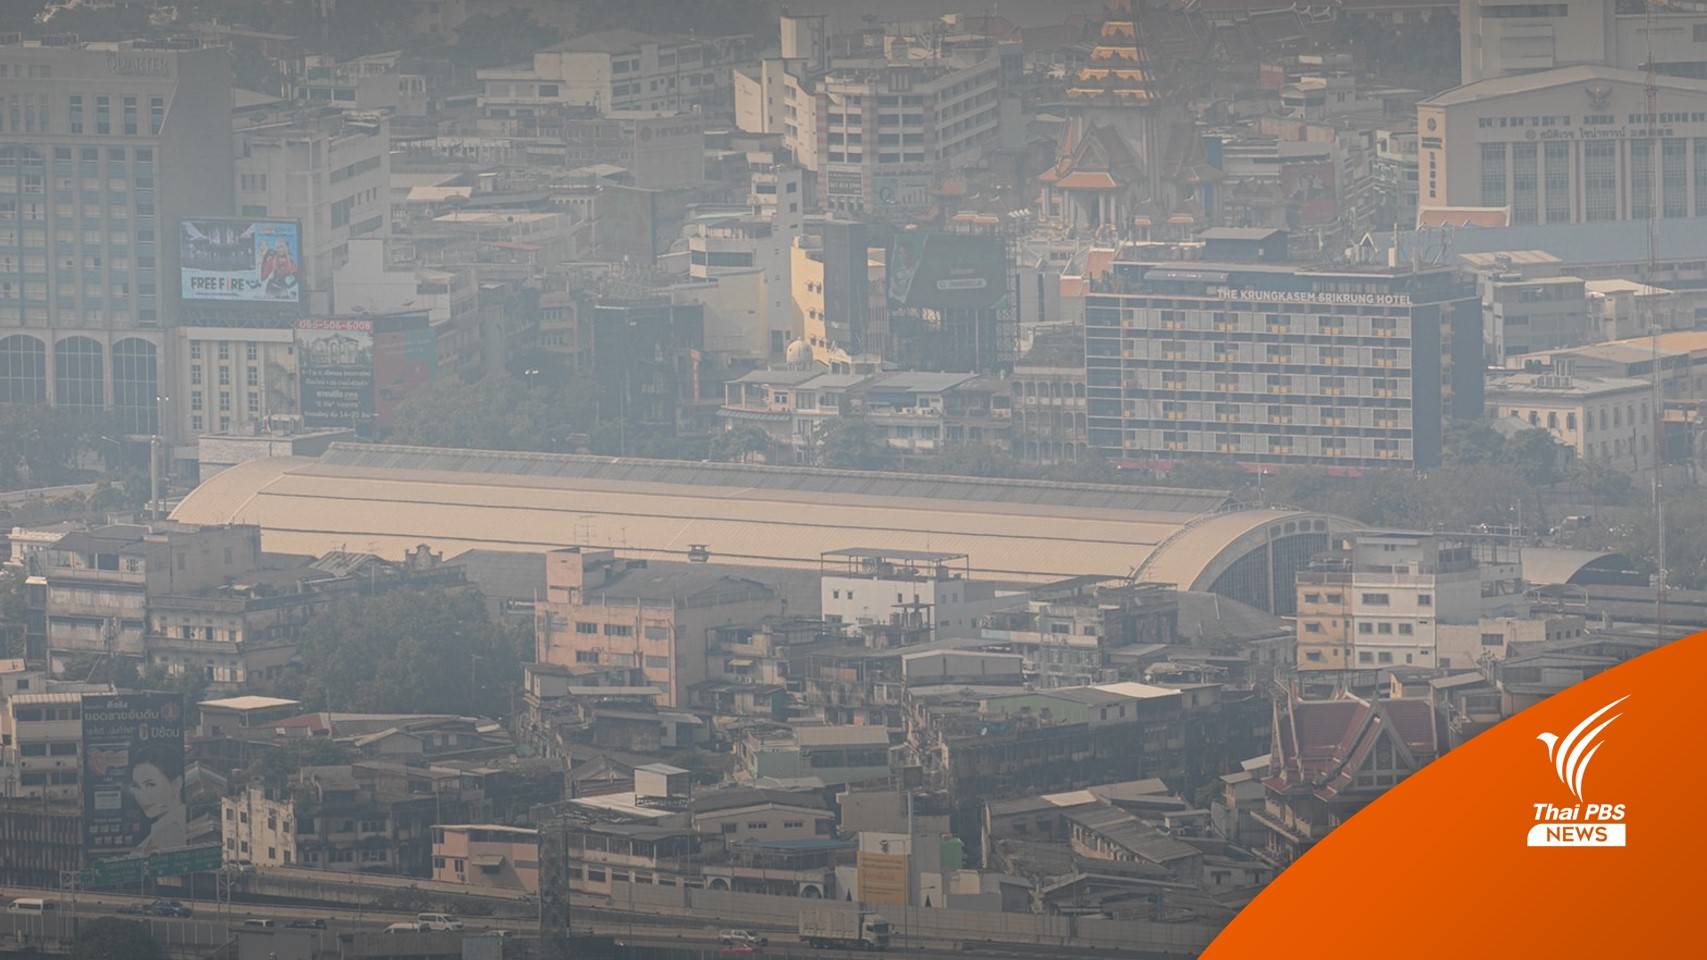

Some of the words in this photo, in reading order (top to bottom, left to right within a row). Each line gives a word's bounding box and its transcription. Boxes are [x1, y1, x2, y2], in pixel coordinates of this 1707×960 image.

[191, 277, 217, 290] FREE
[218, 275, 245, 291] FIRE
[1217, 288, 1238, 300] THE
[1240, 289, 1316, 302] KRUNGKASEM
[1377, 294, 1412, 305] HOTEL
